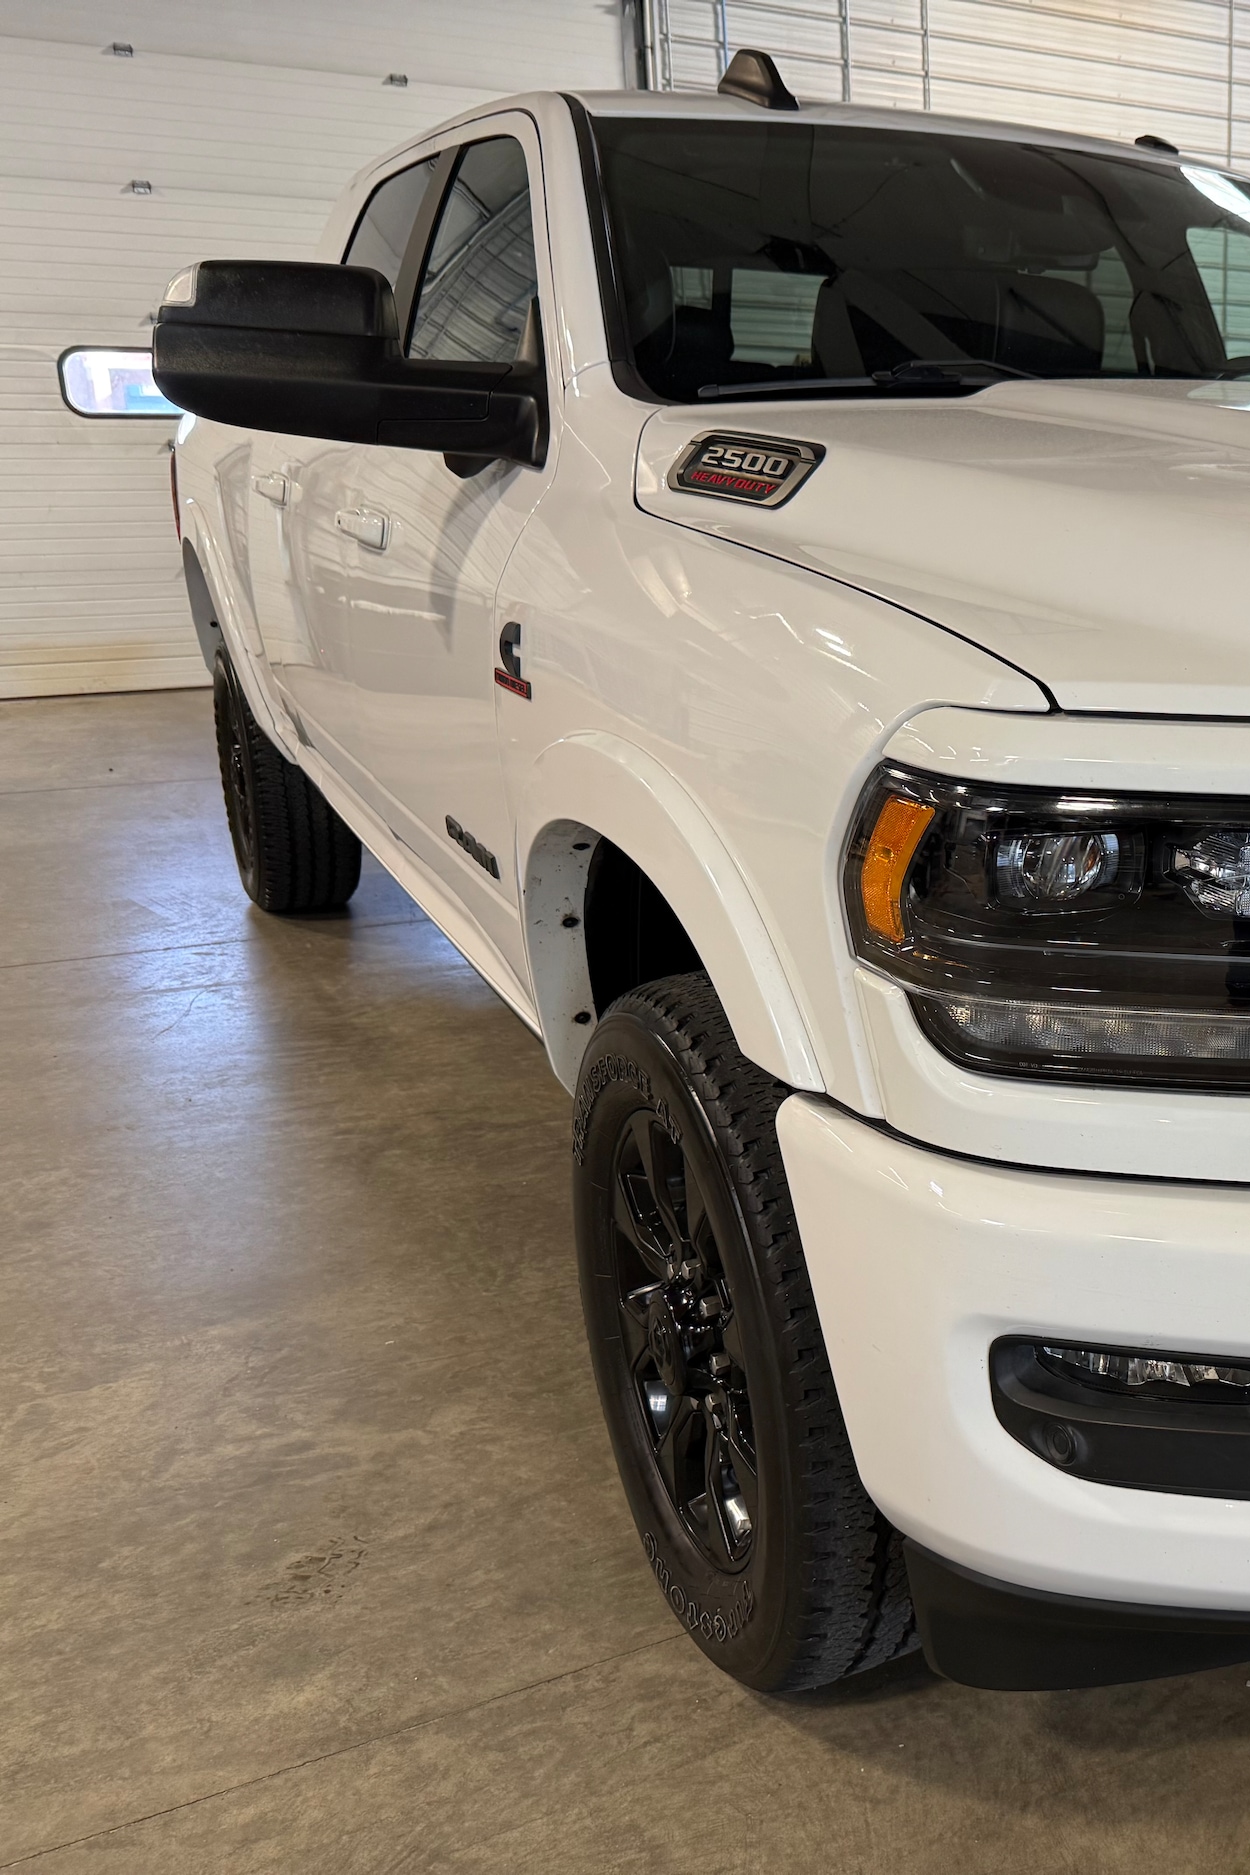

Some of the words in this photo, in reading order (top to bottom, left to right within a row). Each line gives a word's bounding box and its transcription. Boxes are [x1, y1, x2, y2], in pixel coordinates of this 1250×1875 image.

[701, 447, 789, 476] 2500
[690, 471, 735, 487] HEAVY
[733, 478, 777, 494] DUTY
